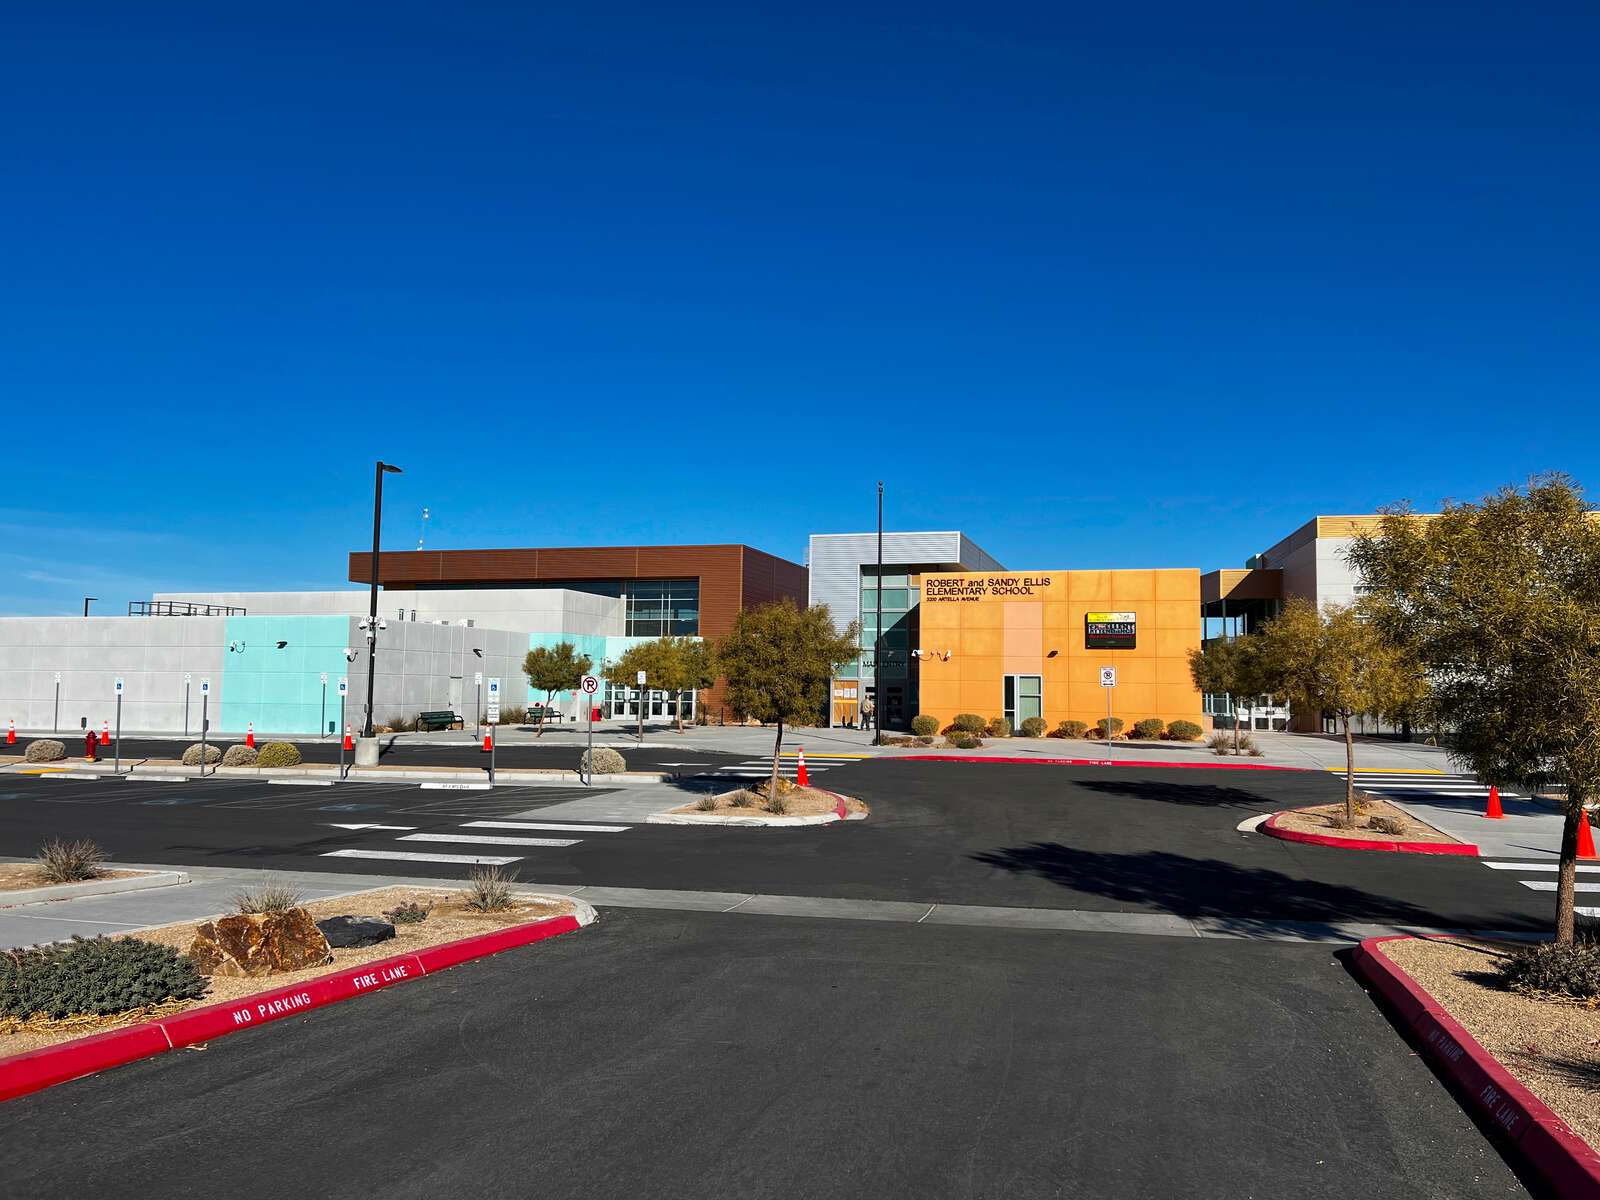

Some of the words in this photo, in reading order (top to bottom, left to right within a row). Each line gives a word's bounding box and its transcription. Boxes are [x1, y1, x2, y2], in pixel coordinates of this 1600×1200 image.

[926, 579, 965, 588] ROBERT
[968, 579, 984, 588] and
[987, 578, 1020, 587] SANDY
[1023, 577, 1051, 587] ELLIS
[926, 587, 988, 596] ELEMENTARY
[991, 586, 1034, 596] SCHOOL
[353, 974, 379, 990] FIRE
[382, 966, 408, 982] LANE
[232, 1009, 251, 1025] NO
[257, 992, 311, 1017] PARKING
[1480, 1085, 1500, 1109] FIRE
[1496, 1102, 1519, 1130] LANE
